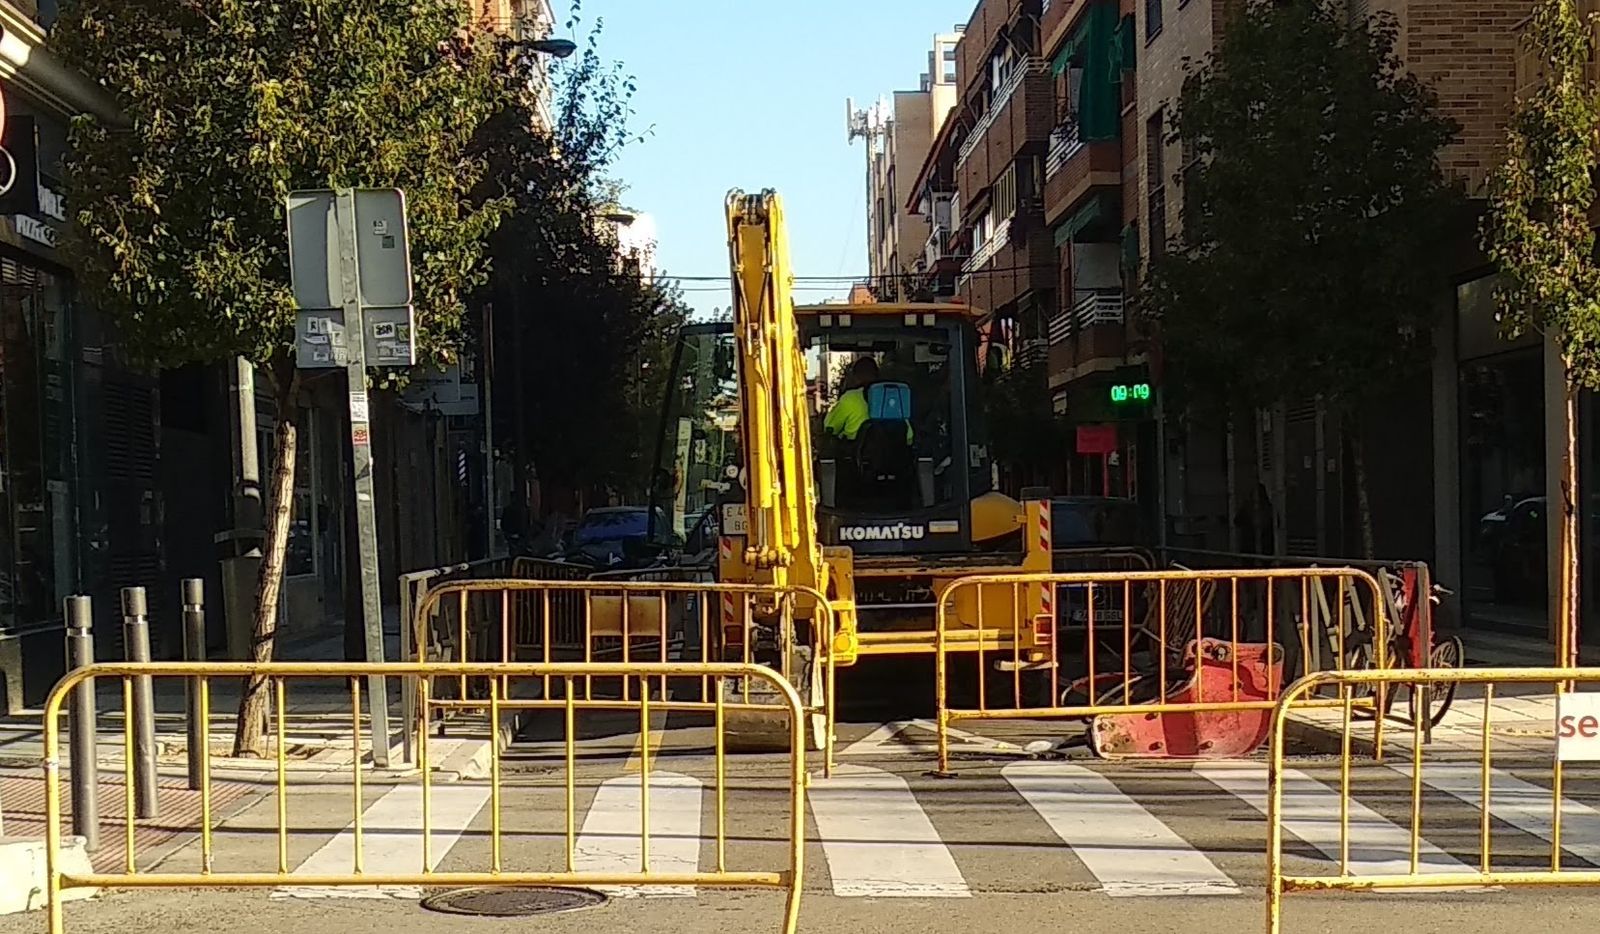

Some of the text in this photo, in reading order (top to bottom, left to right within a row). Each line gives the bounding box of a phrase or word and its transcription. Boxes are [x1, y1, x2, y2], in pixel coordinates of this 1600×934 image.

[1111, 384, 1149, 401] 09:09
[840, 522, 924, 540] KOMATSU
[1559, 715, 1599, 738] se
